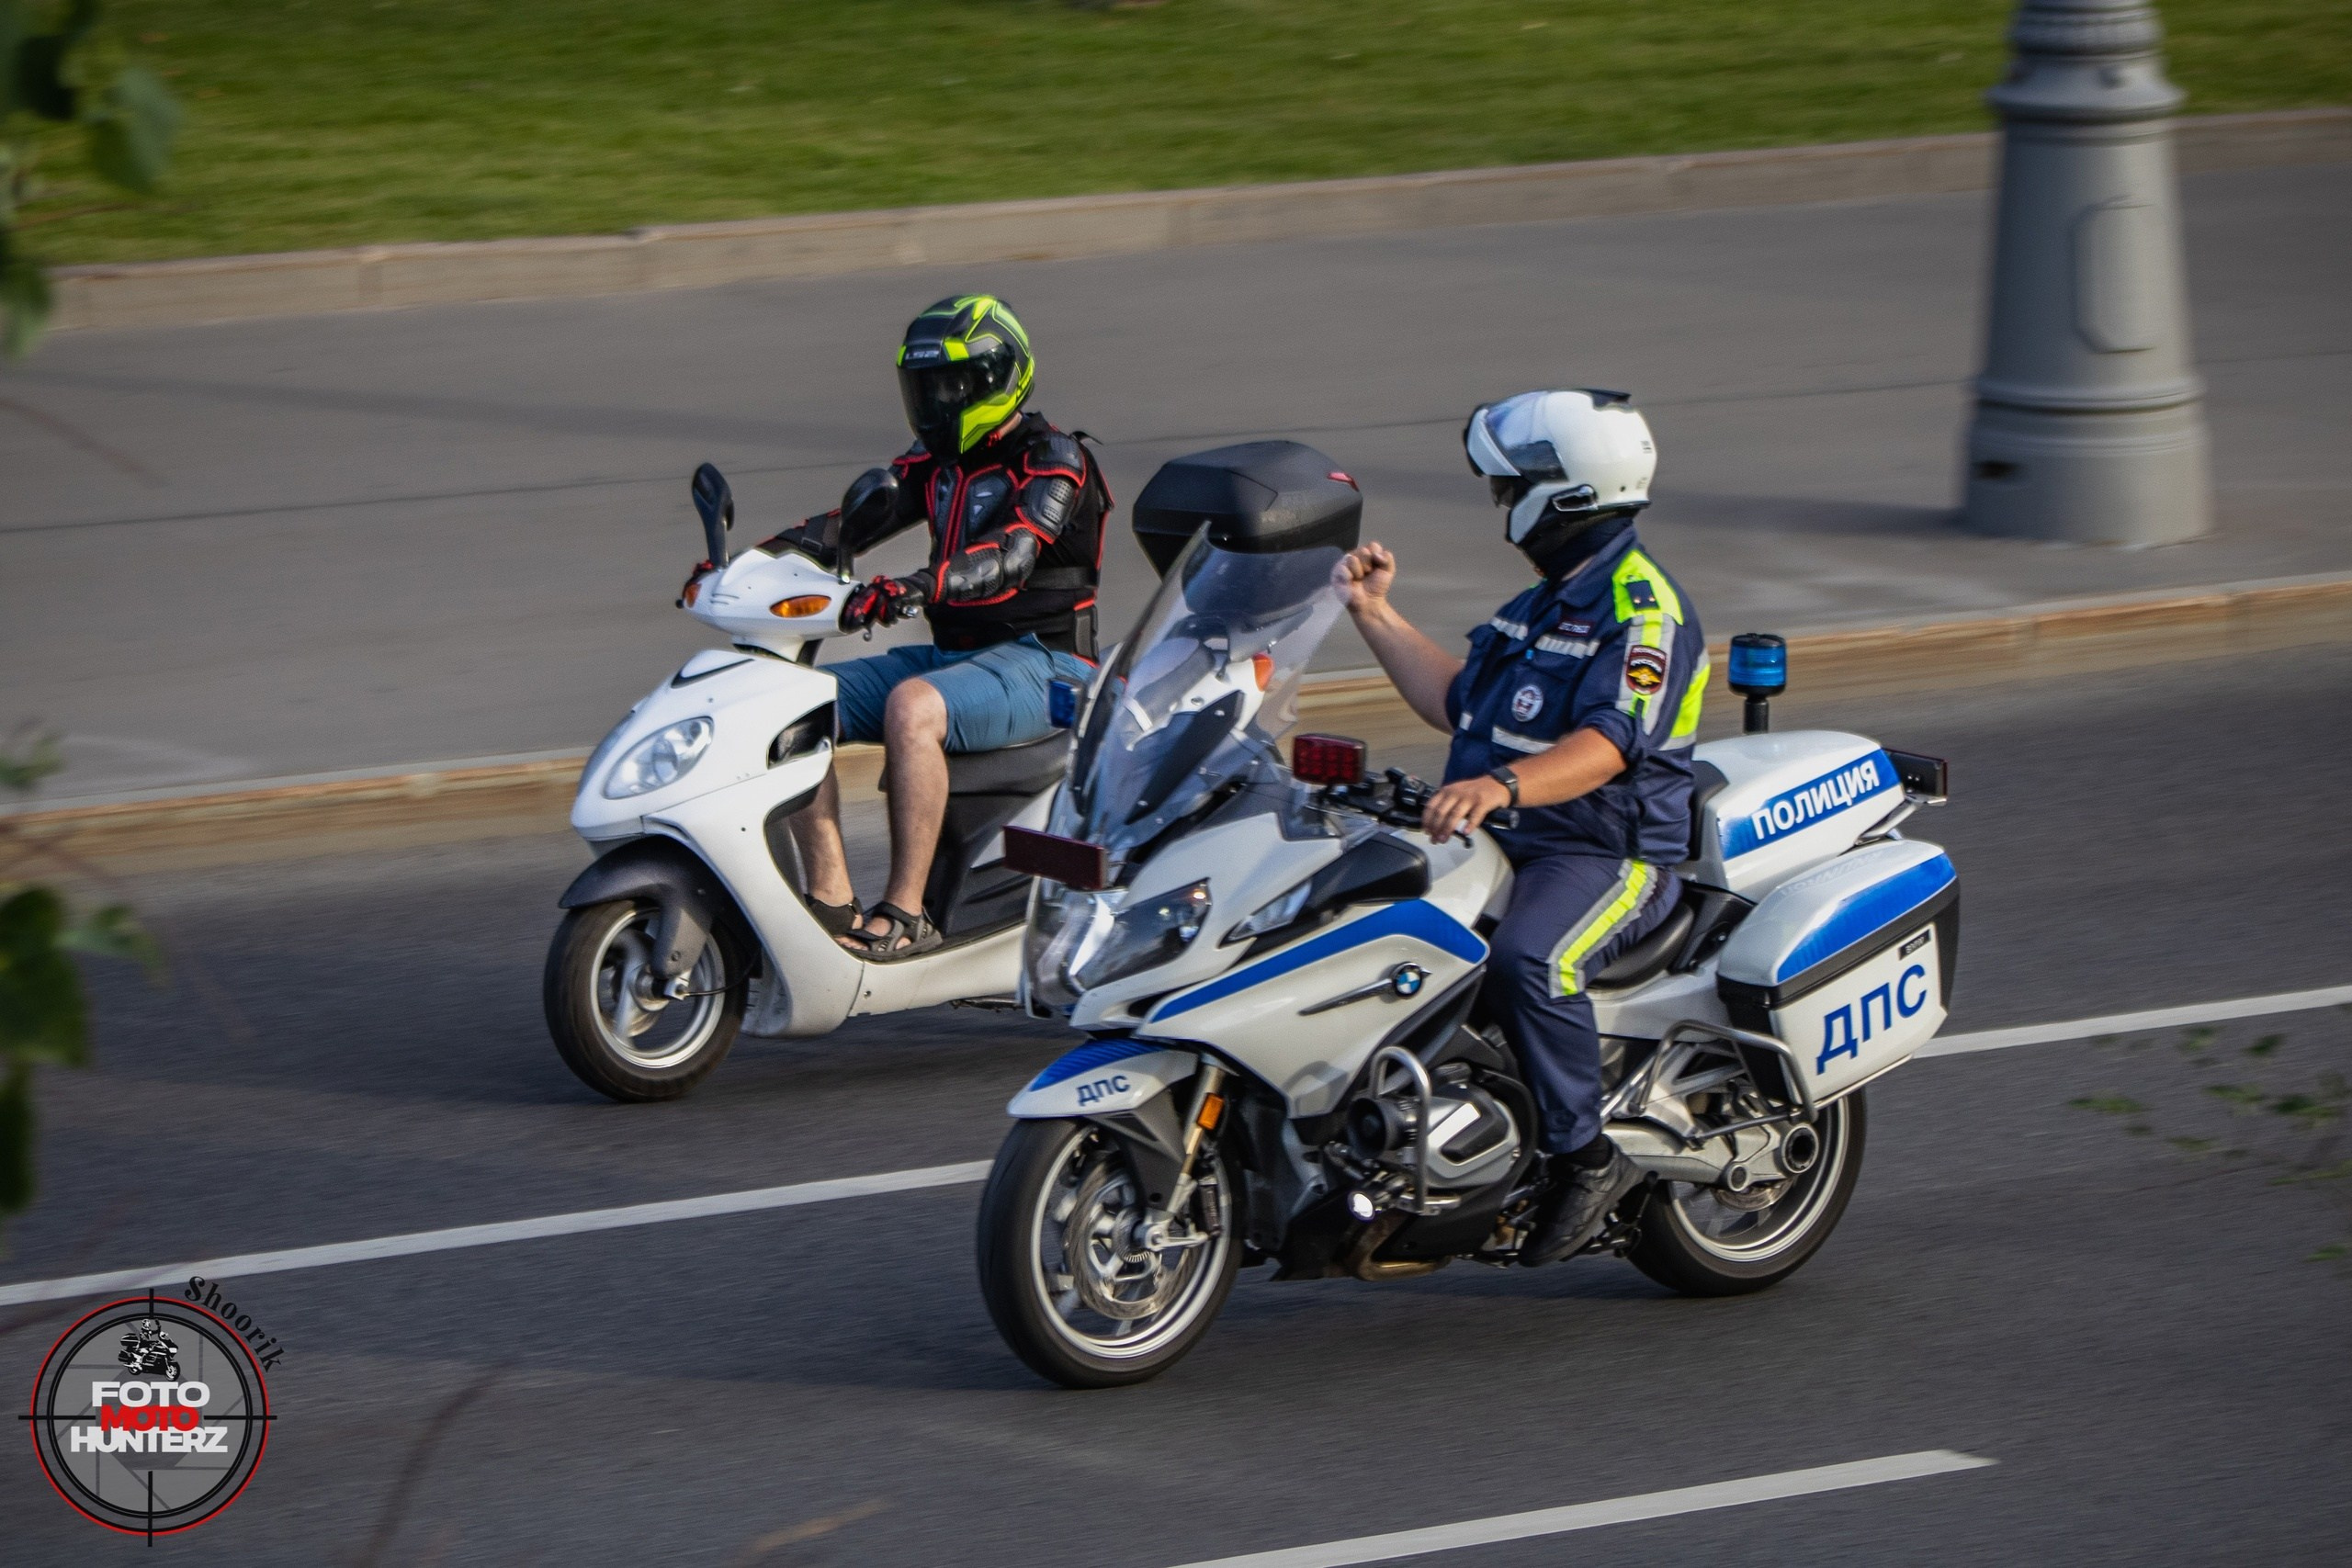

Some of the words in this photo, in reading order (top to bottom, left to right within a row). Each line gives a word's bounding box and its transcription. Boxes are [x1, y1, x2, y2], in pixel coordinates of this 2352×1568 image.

[1751, 759, 1880, 840] ПОЛИЦИЯ
[1815, 964, 1927, 1076] ДПС
[1076, 1075, 1130, 1106] ДПС
